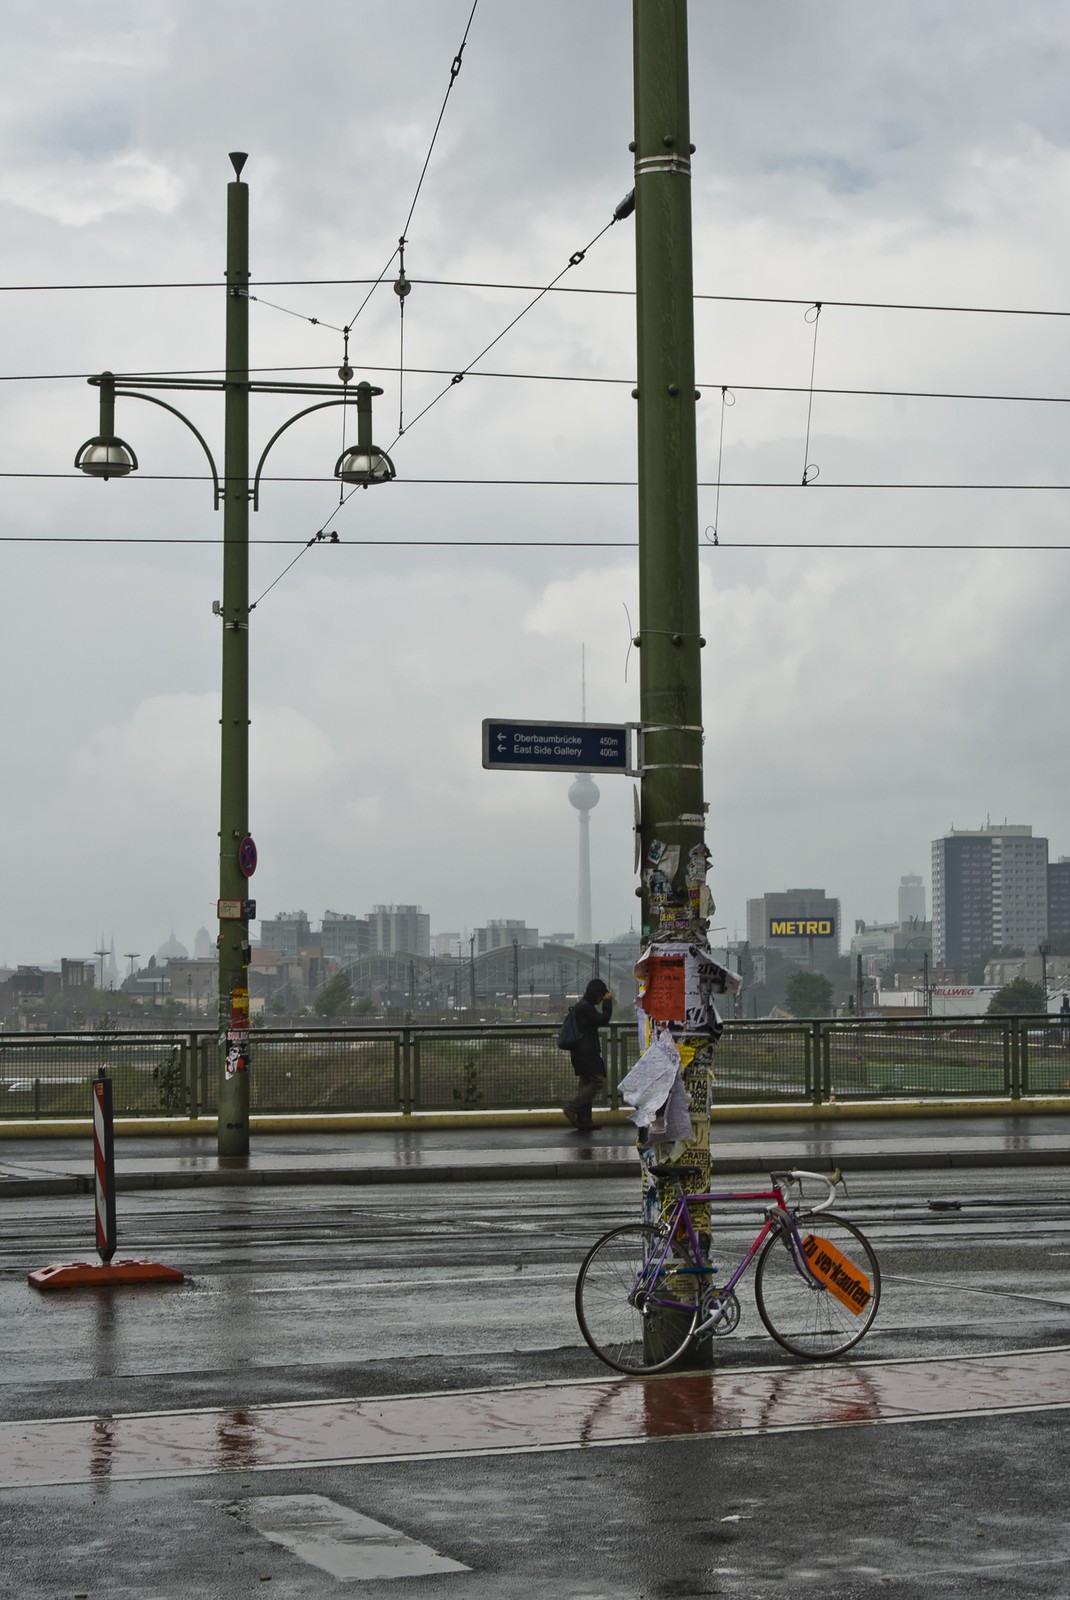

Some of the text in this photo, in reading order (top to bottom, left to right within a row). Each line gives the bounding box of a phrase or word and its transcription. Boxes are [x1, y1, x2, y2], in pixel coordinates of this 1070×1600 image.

[514, 733, 619, 746] Oberbaumbrücke 450m
[513, 745, 619, 758] East Side Gallery 400m
[771, 920, 832, 936] METRO
[814, 1250, 871, 1307] verkaufen
